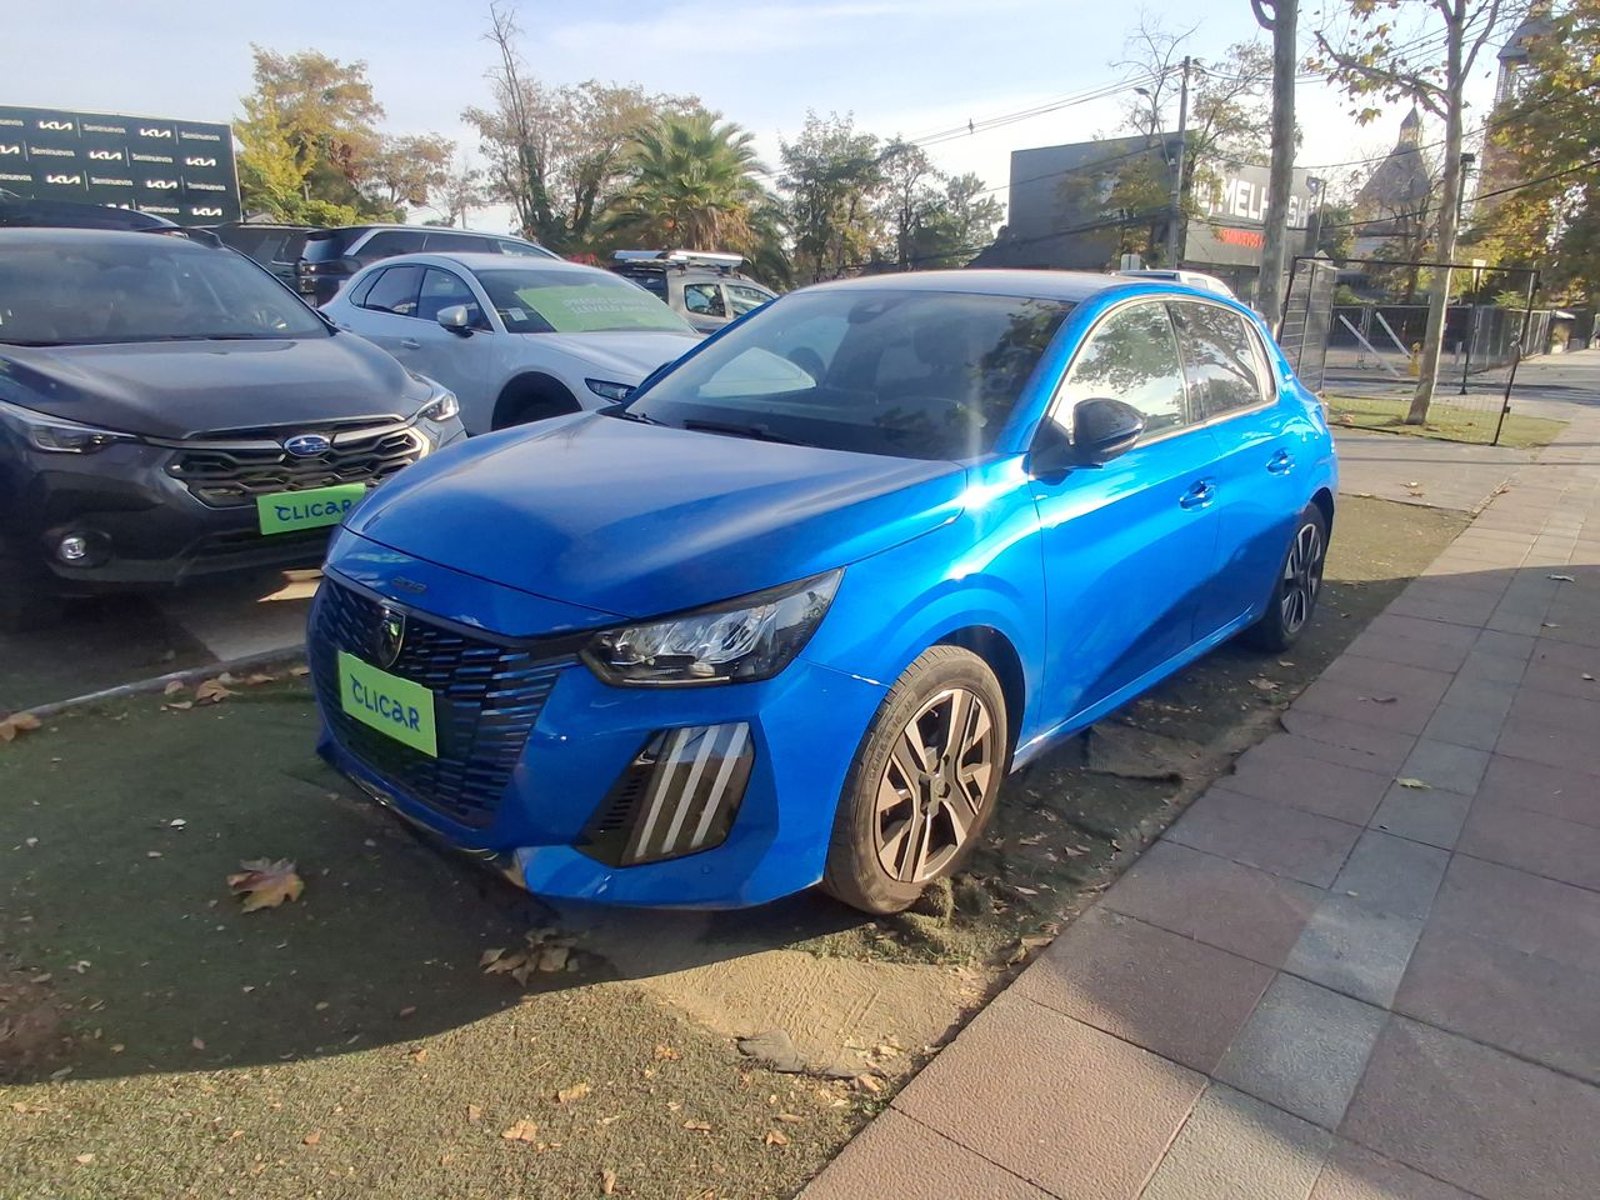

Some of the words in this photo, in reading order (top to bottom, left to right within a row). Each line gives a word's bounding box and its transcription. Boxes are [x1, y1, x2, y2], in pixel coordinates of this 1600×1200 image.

[39, 121, 73, 131] KIA
[140, 128, 171, 138] KIA
[30, 147, 75, 157] Seminuevos
[89, 151, 122, 161] KIA
[185, 157, 217, 167] KIA
[46, 175, 81, 185] KIA
[146, 180, 178, 189] KIA
[192, 207, 222, 217] KIA
